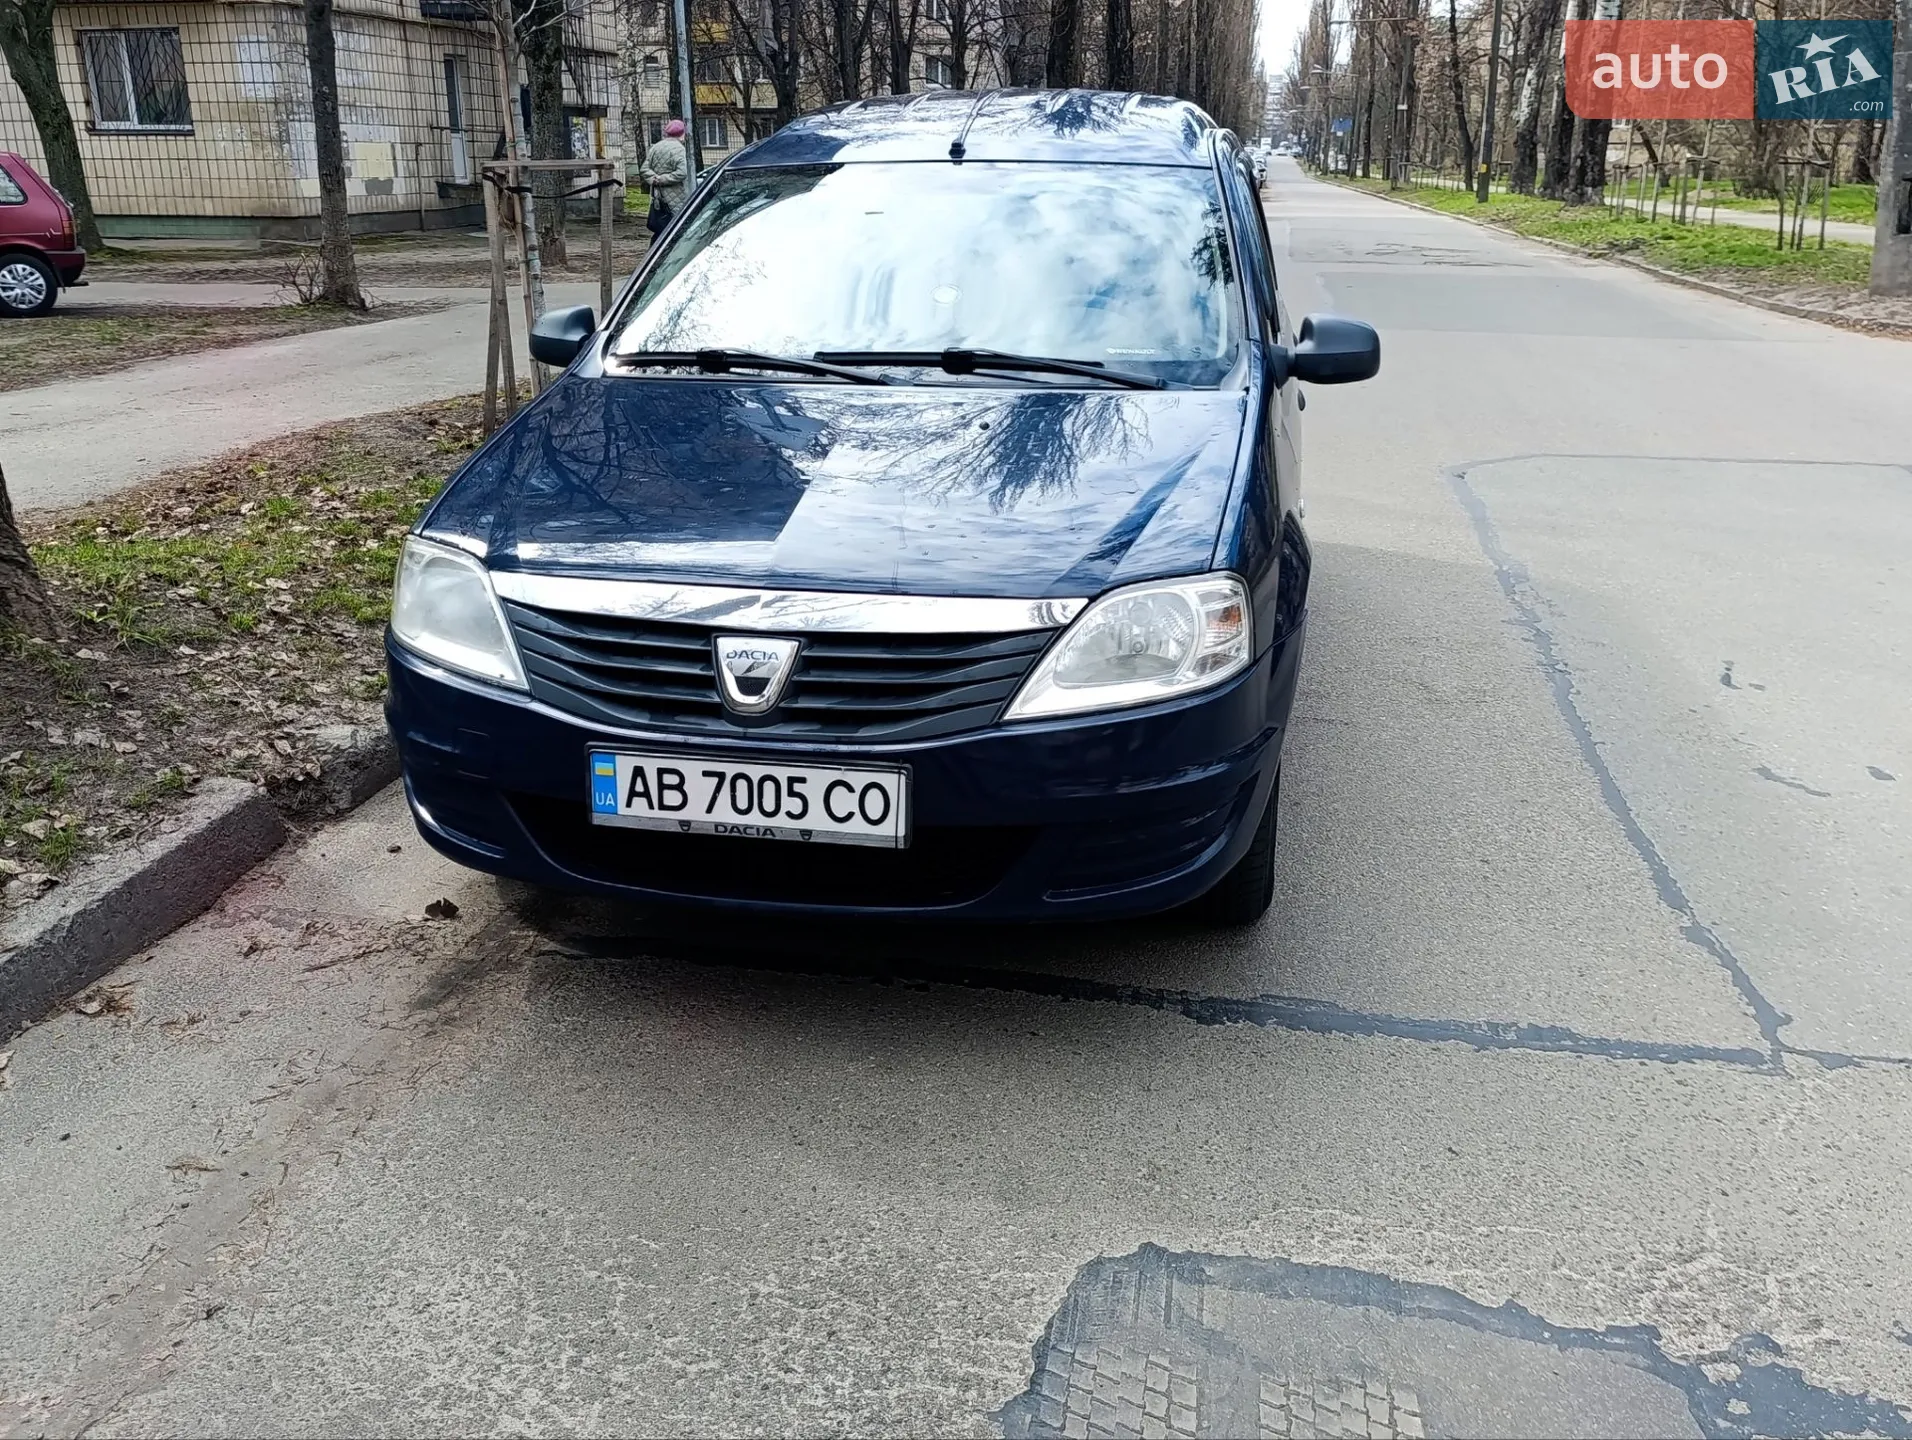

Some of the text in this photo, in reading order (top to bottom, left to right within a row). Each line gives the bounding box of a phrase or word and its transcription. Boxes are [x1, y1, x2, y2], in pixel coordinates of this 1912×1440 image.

[726, 649, 779, 661] DACIA
[595, 791, 616, 807] UA
[625, 765, 891, 826] AB 7005 CO
[714, 823, 777, 838] DACIA
